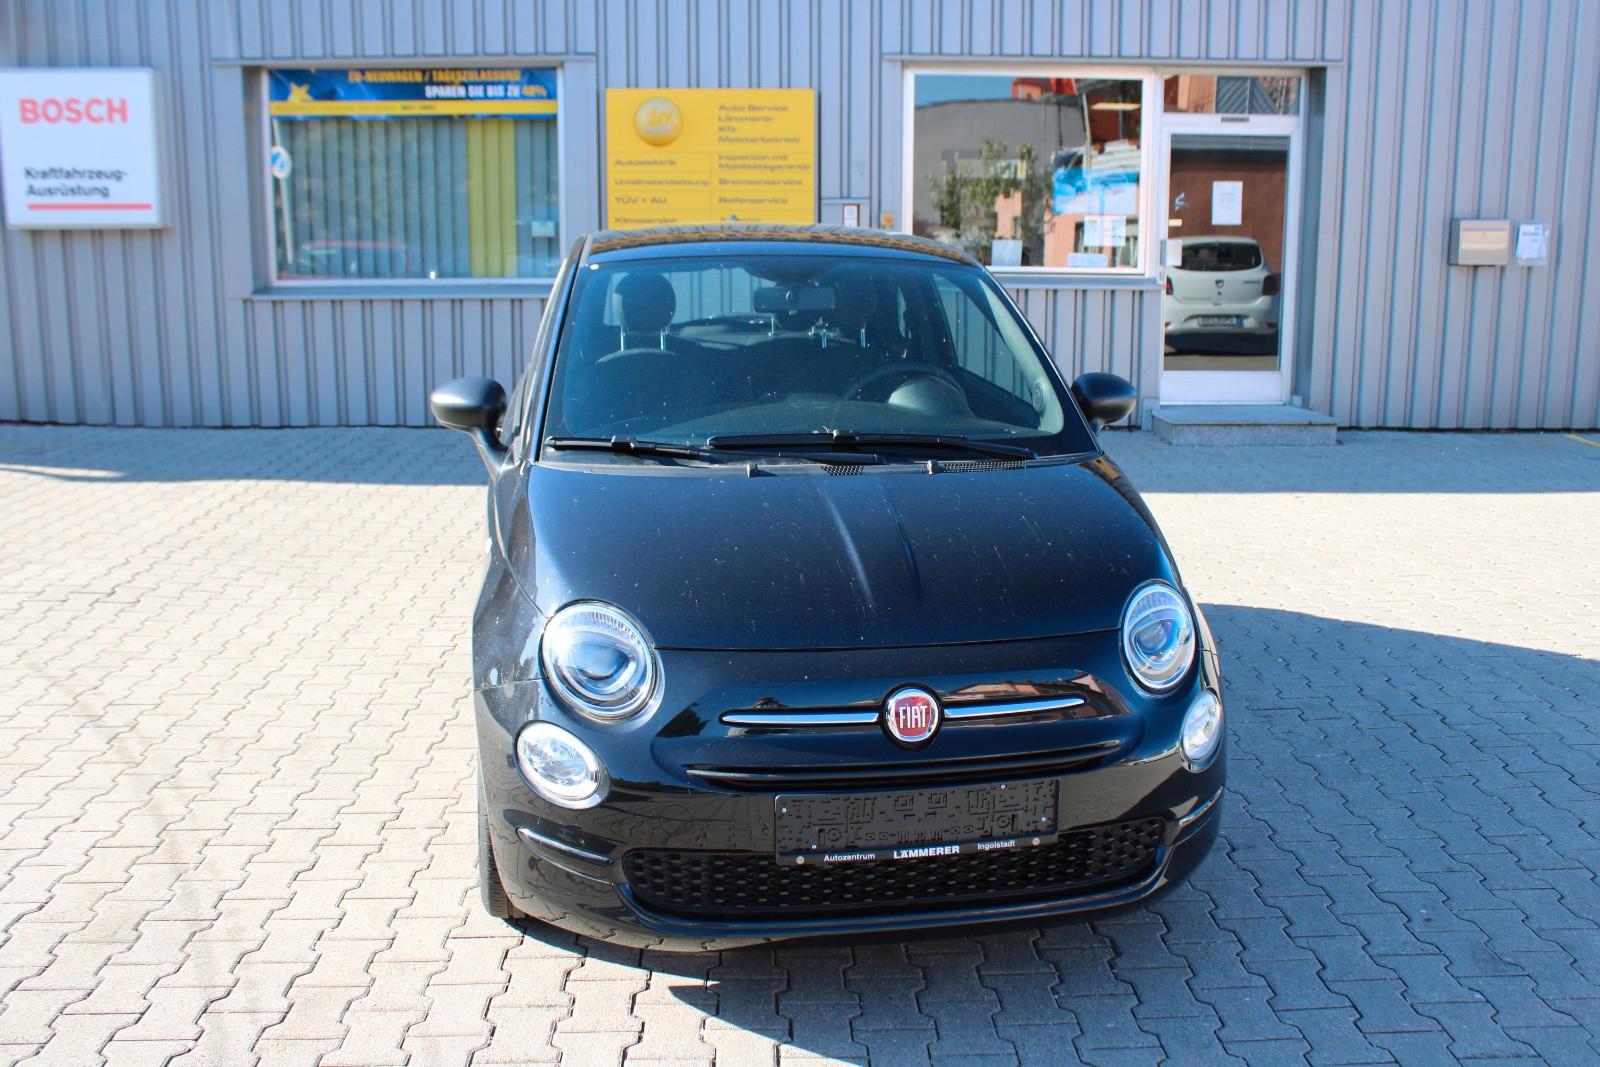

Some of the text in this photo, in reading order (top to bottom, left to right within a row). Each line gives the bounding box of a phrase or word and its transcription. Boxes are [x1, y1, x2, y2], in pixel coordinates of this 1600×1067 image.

[425, 85, 465, 98] SPAREN
[468, 85, 484, 98] SIE
[19, 97, 128, 124] BOSCH
[24, 166, 127, 182] Kraftfahrzeug-
[27, 183, 110, 198] Ausrüstung
[899, 703, 928, 729] FIAT
[823, 839, 1016, 863] Autozentrum LÄMMERER Ingolstadt
